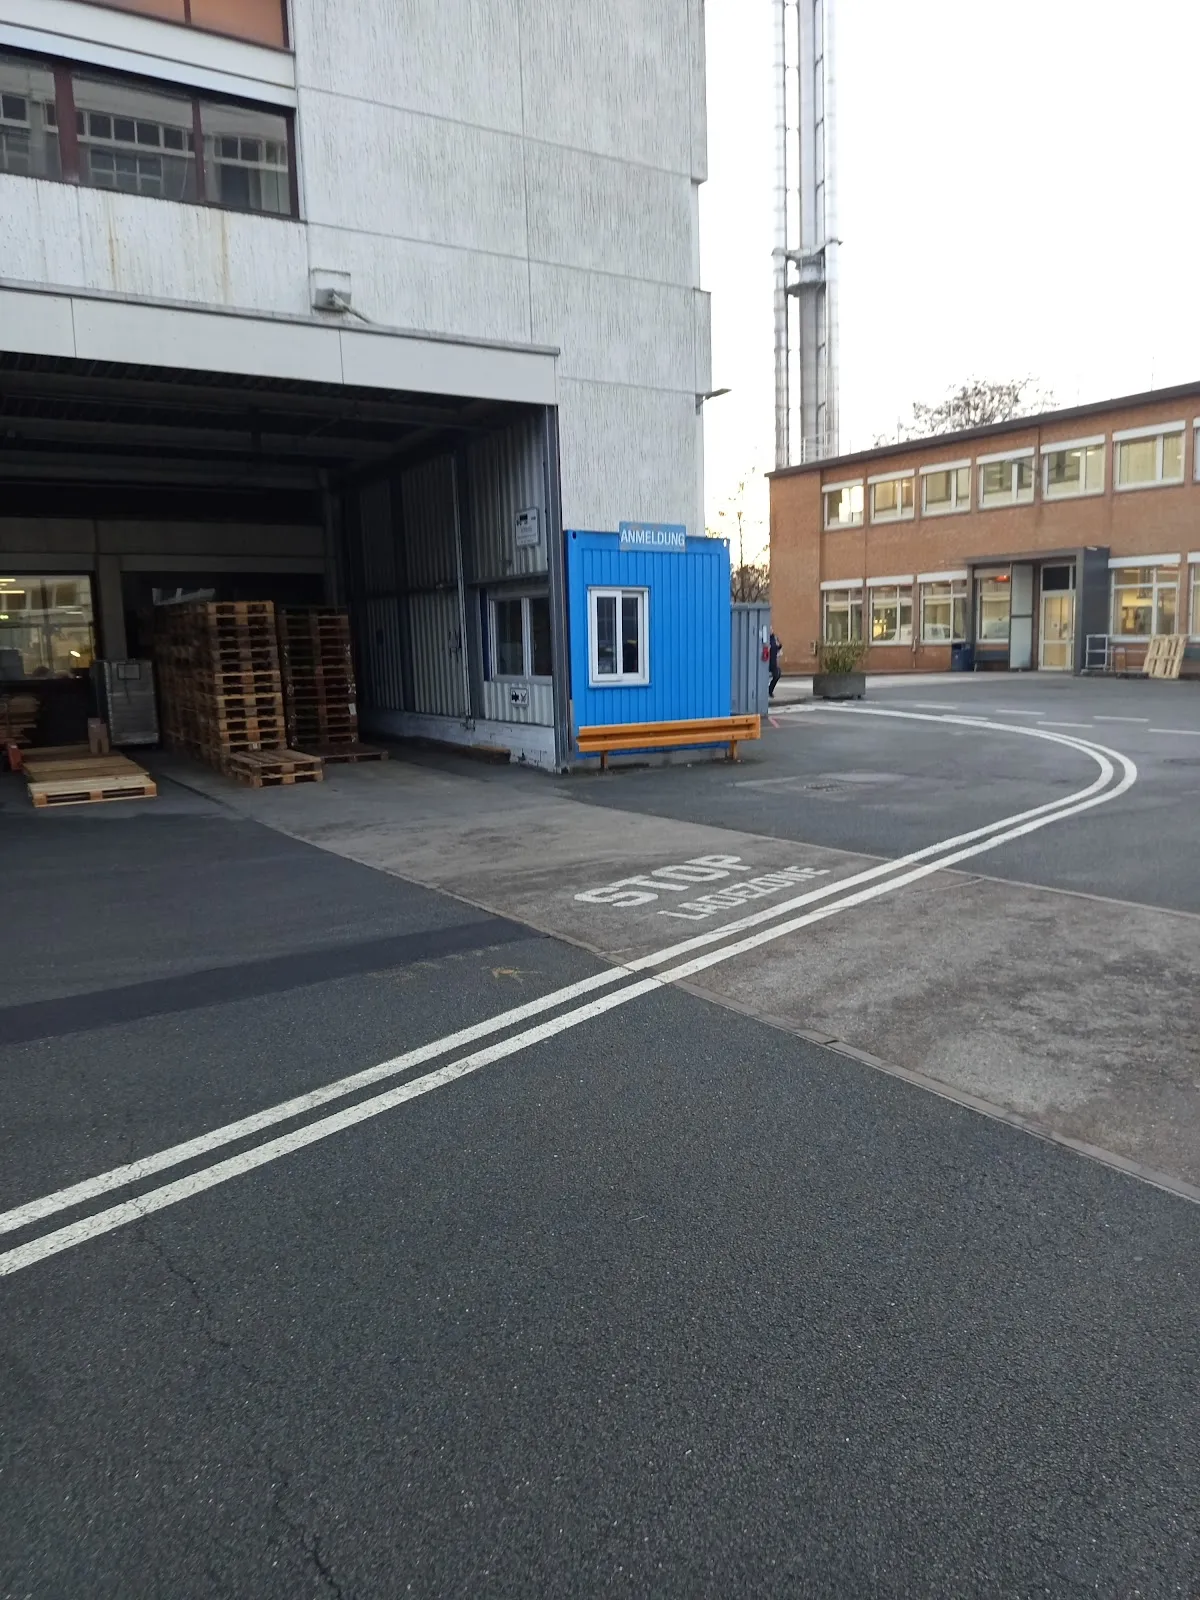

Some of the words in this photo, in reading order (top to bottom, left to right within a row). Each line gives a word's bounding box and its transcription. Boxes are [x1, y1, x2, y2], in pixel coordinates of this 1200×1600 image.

[620, 529, 685, 546] ANMELDUNG
[574, 855, 752, 907] STOP
[657, 866, 831, 920] LADEZONE
